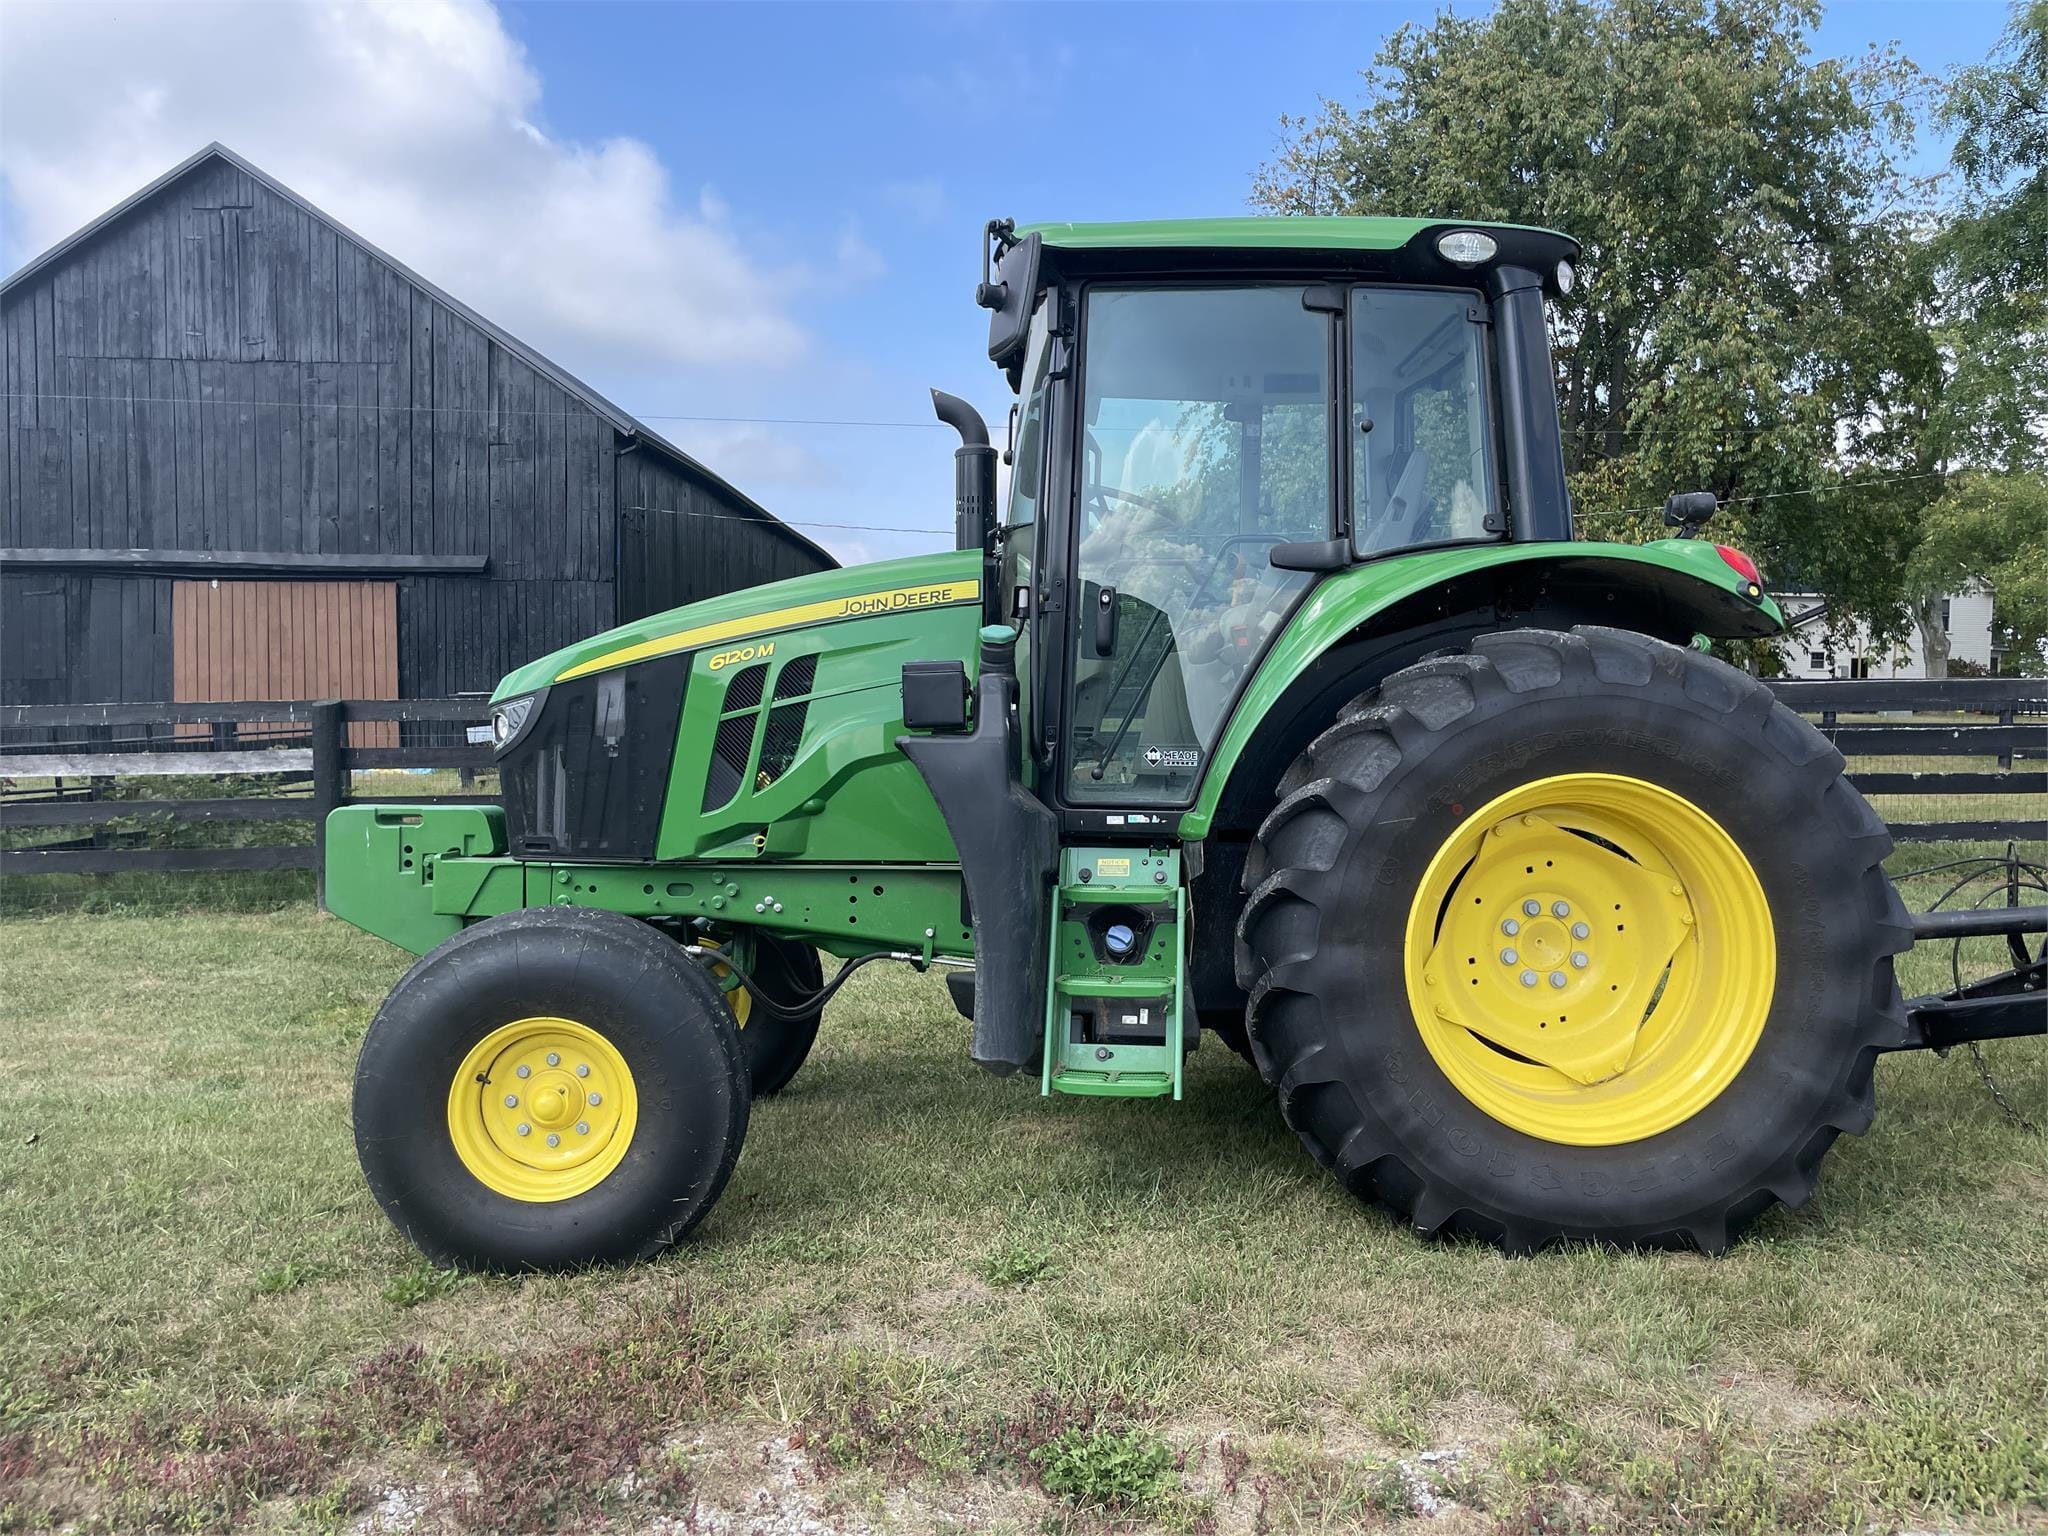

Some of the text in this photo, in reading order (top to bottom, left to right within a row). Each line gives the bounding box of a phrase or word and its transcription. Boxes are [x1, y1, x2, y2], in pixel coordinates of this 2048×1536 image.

[839, 588, 952, 615] JOHN DEERE
[708, 642, 776, 671] 6120 M
[1163, 751, 1197, 760] MEADE
